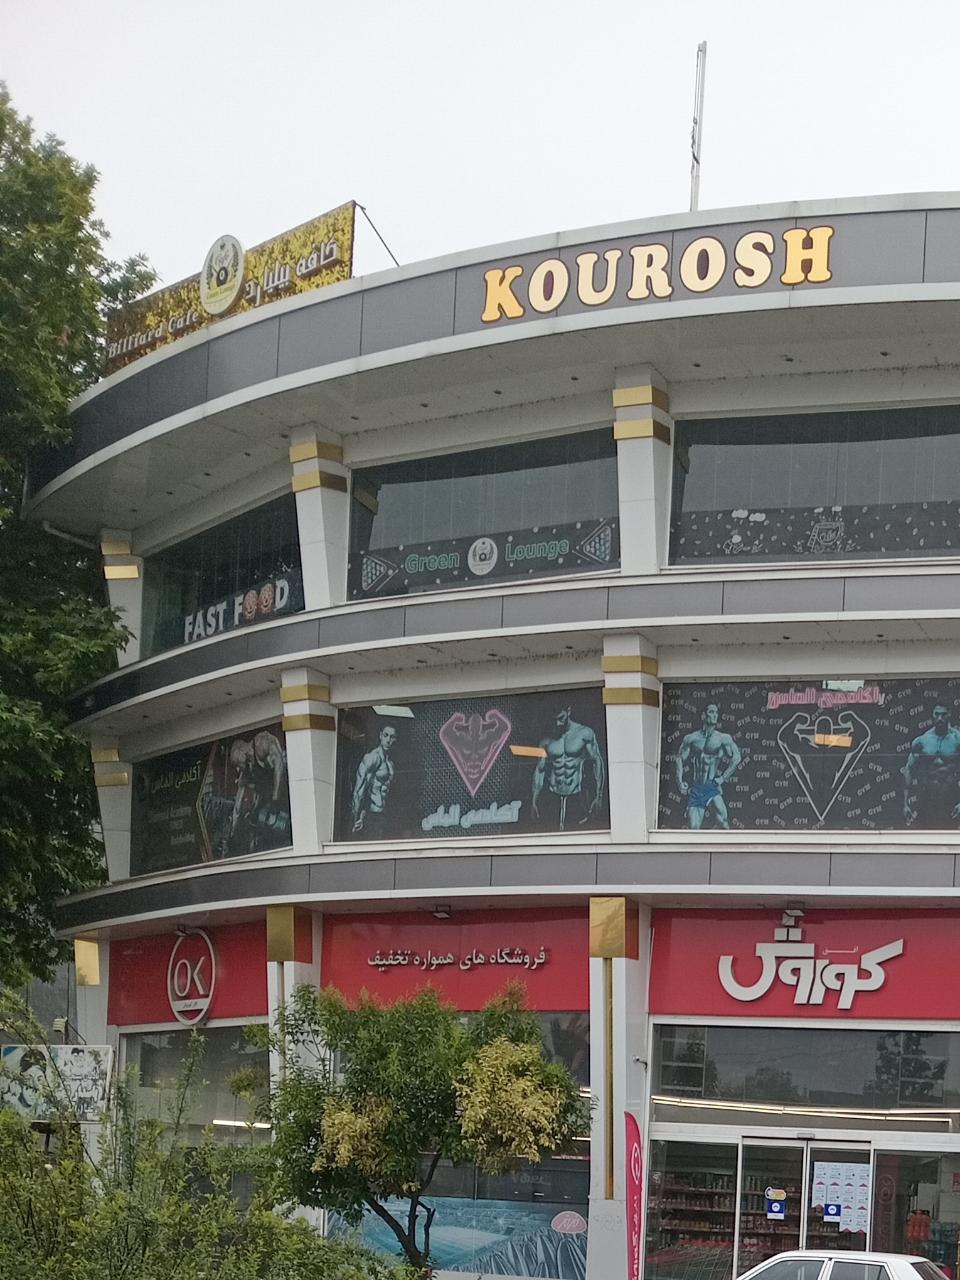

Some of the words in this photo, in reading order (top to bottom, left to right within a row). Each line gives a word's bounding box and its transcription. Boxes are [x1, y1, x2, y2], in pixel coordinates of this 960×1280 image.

[480, 225, 834, 323] KOUROSH
[108, 323, 163, 359] Billiard
[405, 550, 460, 574] Green
[505, 537, 570, 562] Lounge
[183, 606, 227, 644] FAST
[233, 578, 289, 626] FOOD
[367, 949, 411, 972] تخفیف
[413, 949, 455, 970] همواره
[459, 948, 485, 970] های
[489, 945, 546, 971] فروشگاه
[174, 956, 206, 997] OK
